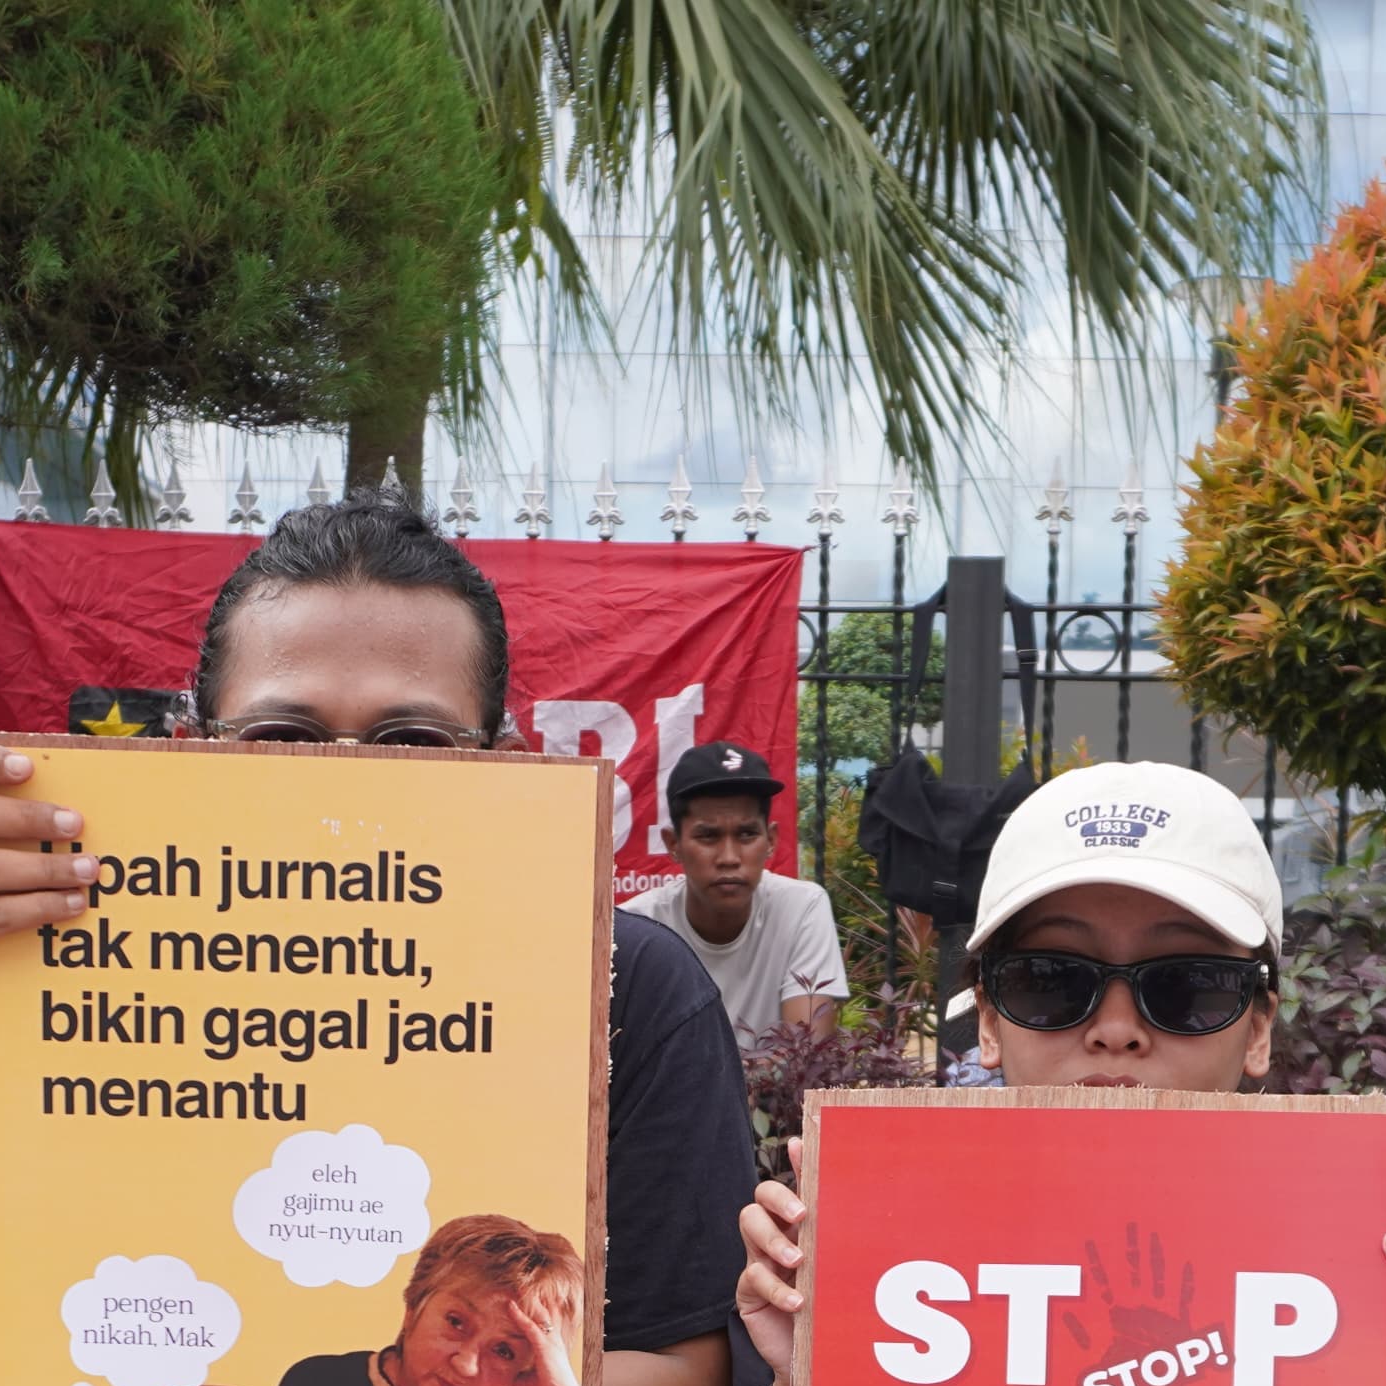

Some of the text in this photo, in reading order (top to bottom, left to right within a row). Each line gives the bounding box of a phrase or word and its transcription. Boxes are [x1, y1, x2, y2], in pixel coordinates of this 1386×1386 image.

[1064, 804, 1171, 829] COLLEGE
[1095, 821, 1132, 834] 1933
[1084, 836, 1141, 849] CLASSIC
[40, 839, 442, 912] pah jurnalis
[38, 917, 432, 988] tak menentu,
[42, 991, 492, 1065] bikin gagal jadi
[43, 1073, 306, 1121] menantu
[311, 1163, 358, 1185] eleh
[282, 1192, 384, 1218] gajimu ae
[268, 1222, 404, 1246] nyut-nyutan
[101, 1295, 195, 1323] pengen
[83, 1323, 217, 1349] nikah, Mak
